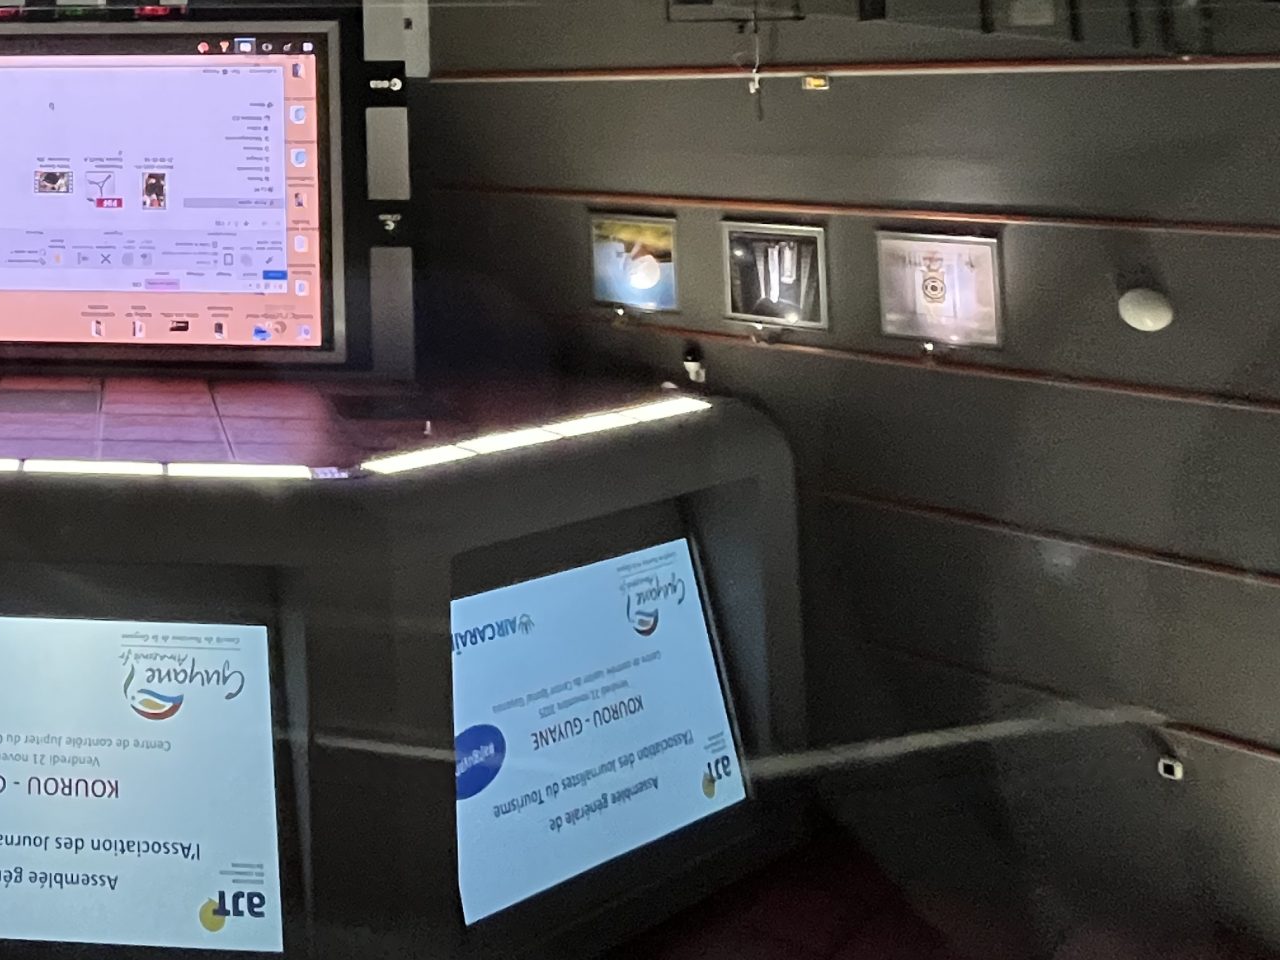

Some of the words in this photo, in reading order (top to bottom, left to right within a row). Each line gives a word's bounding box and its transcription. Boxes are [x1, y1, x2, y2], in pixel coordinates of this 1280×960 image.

[145, 657, 245, 701] Guyane
[593, 695, 644, 728] KOUROU
[6, 734, 21, 746] du
[24, 734, 62, 747] Jupiter
[530, 716, 583, 751] GUYANE
[65, 736, 112, 750] contrôle
[115, 738, 130, 751] de
[133, 739, 171, 752] Centre
[33, 753, 46, 765] 21
[49, 754, 100, 768] Vendredi
[618, 752, 635, 769] des
[561, 759, 616, 790] Journalistes
[27, 776, 119, 799] KOUROU
[545, 782, 559, 798] du
[611, 776, 659, 804] Assemblée
[493, 789, 544, 818] Tourisme
[564, 792, 608, 826] générale
[549, 816, 563, 832] de
[55, 837, 84, 854] des
[28, 872, 118, 891] Assemblée
